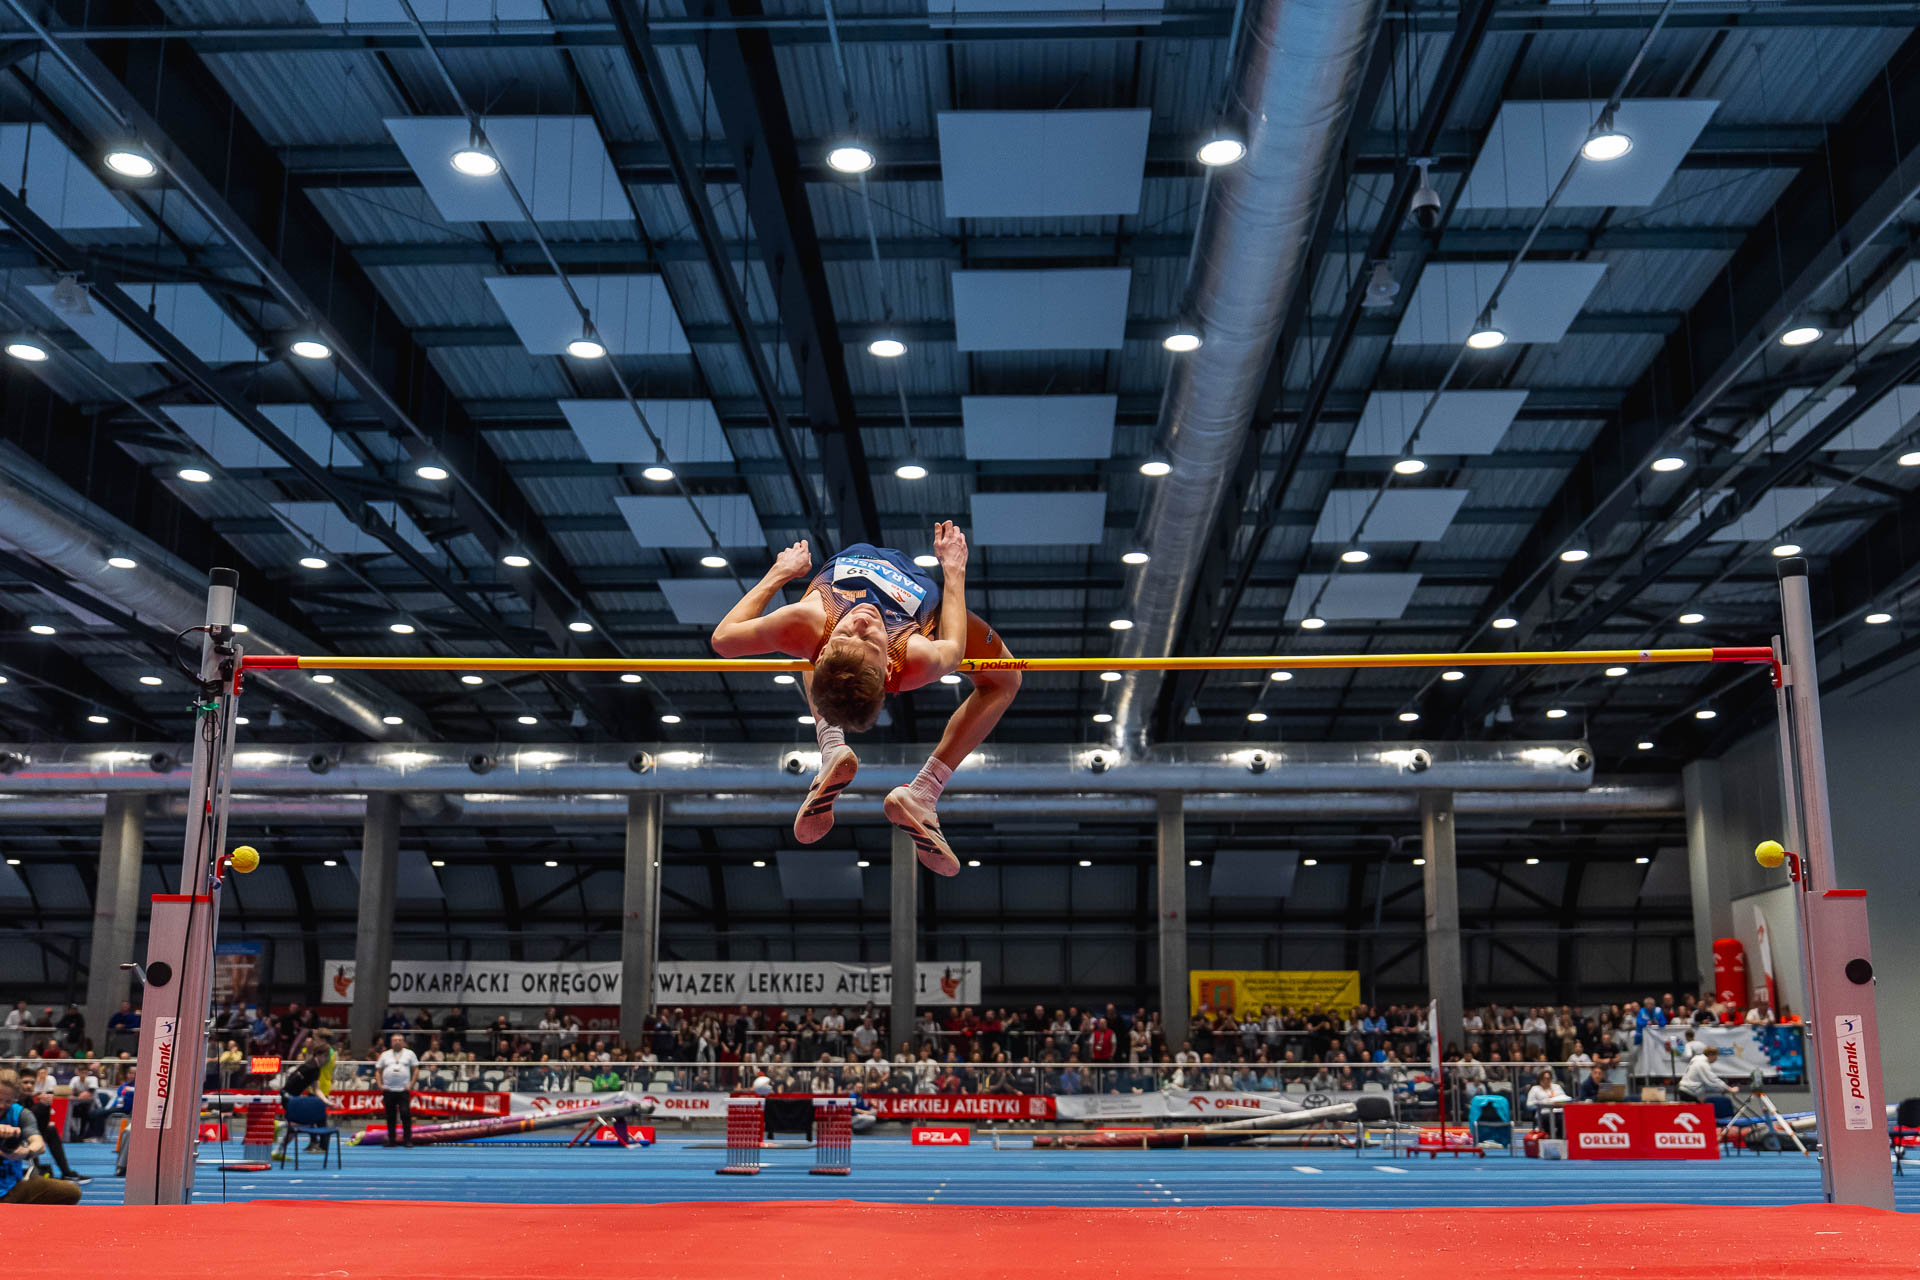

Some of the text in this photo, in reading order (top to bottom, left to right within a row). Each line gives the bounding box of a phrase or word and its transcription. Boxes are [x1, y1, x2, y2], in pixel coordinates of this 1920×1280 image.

[846, 567, 869, 576] 39
[980, 660, 1028, 670] polanik
[388, 972, 926, 996] ODKARPACKI OKRĘGOW WIĄZEK LEKKIEJ ATLETI
[156, 1042, 171, 1098] polanik
[1843, 1040, 1864, 1099] polanik
[350, 1095, 384, 1109] LEKK
[664, 1098, 710, 1109] ORLEN
[892, 1099, 949, 1113] LEKKIEJ
[953, 1099, 1020, 1113] ATLETYKI
[1214, 1098, 1261, 1109] ORLEN
[919, 1131, 963, 1142] PZLA
[1583, 1135, 1626, 1145] ORLEN
[1659, 1135, 1701, 1145] ORLEN
